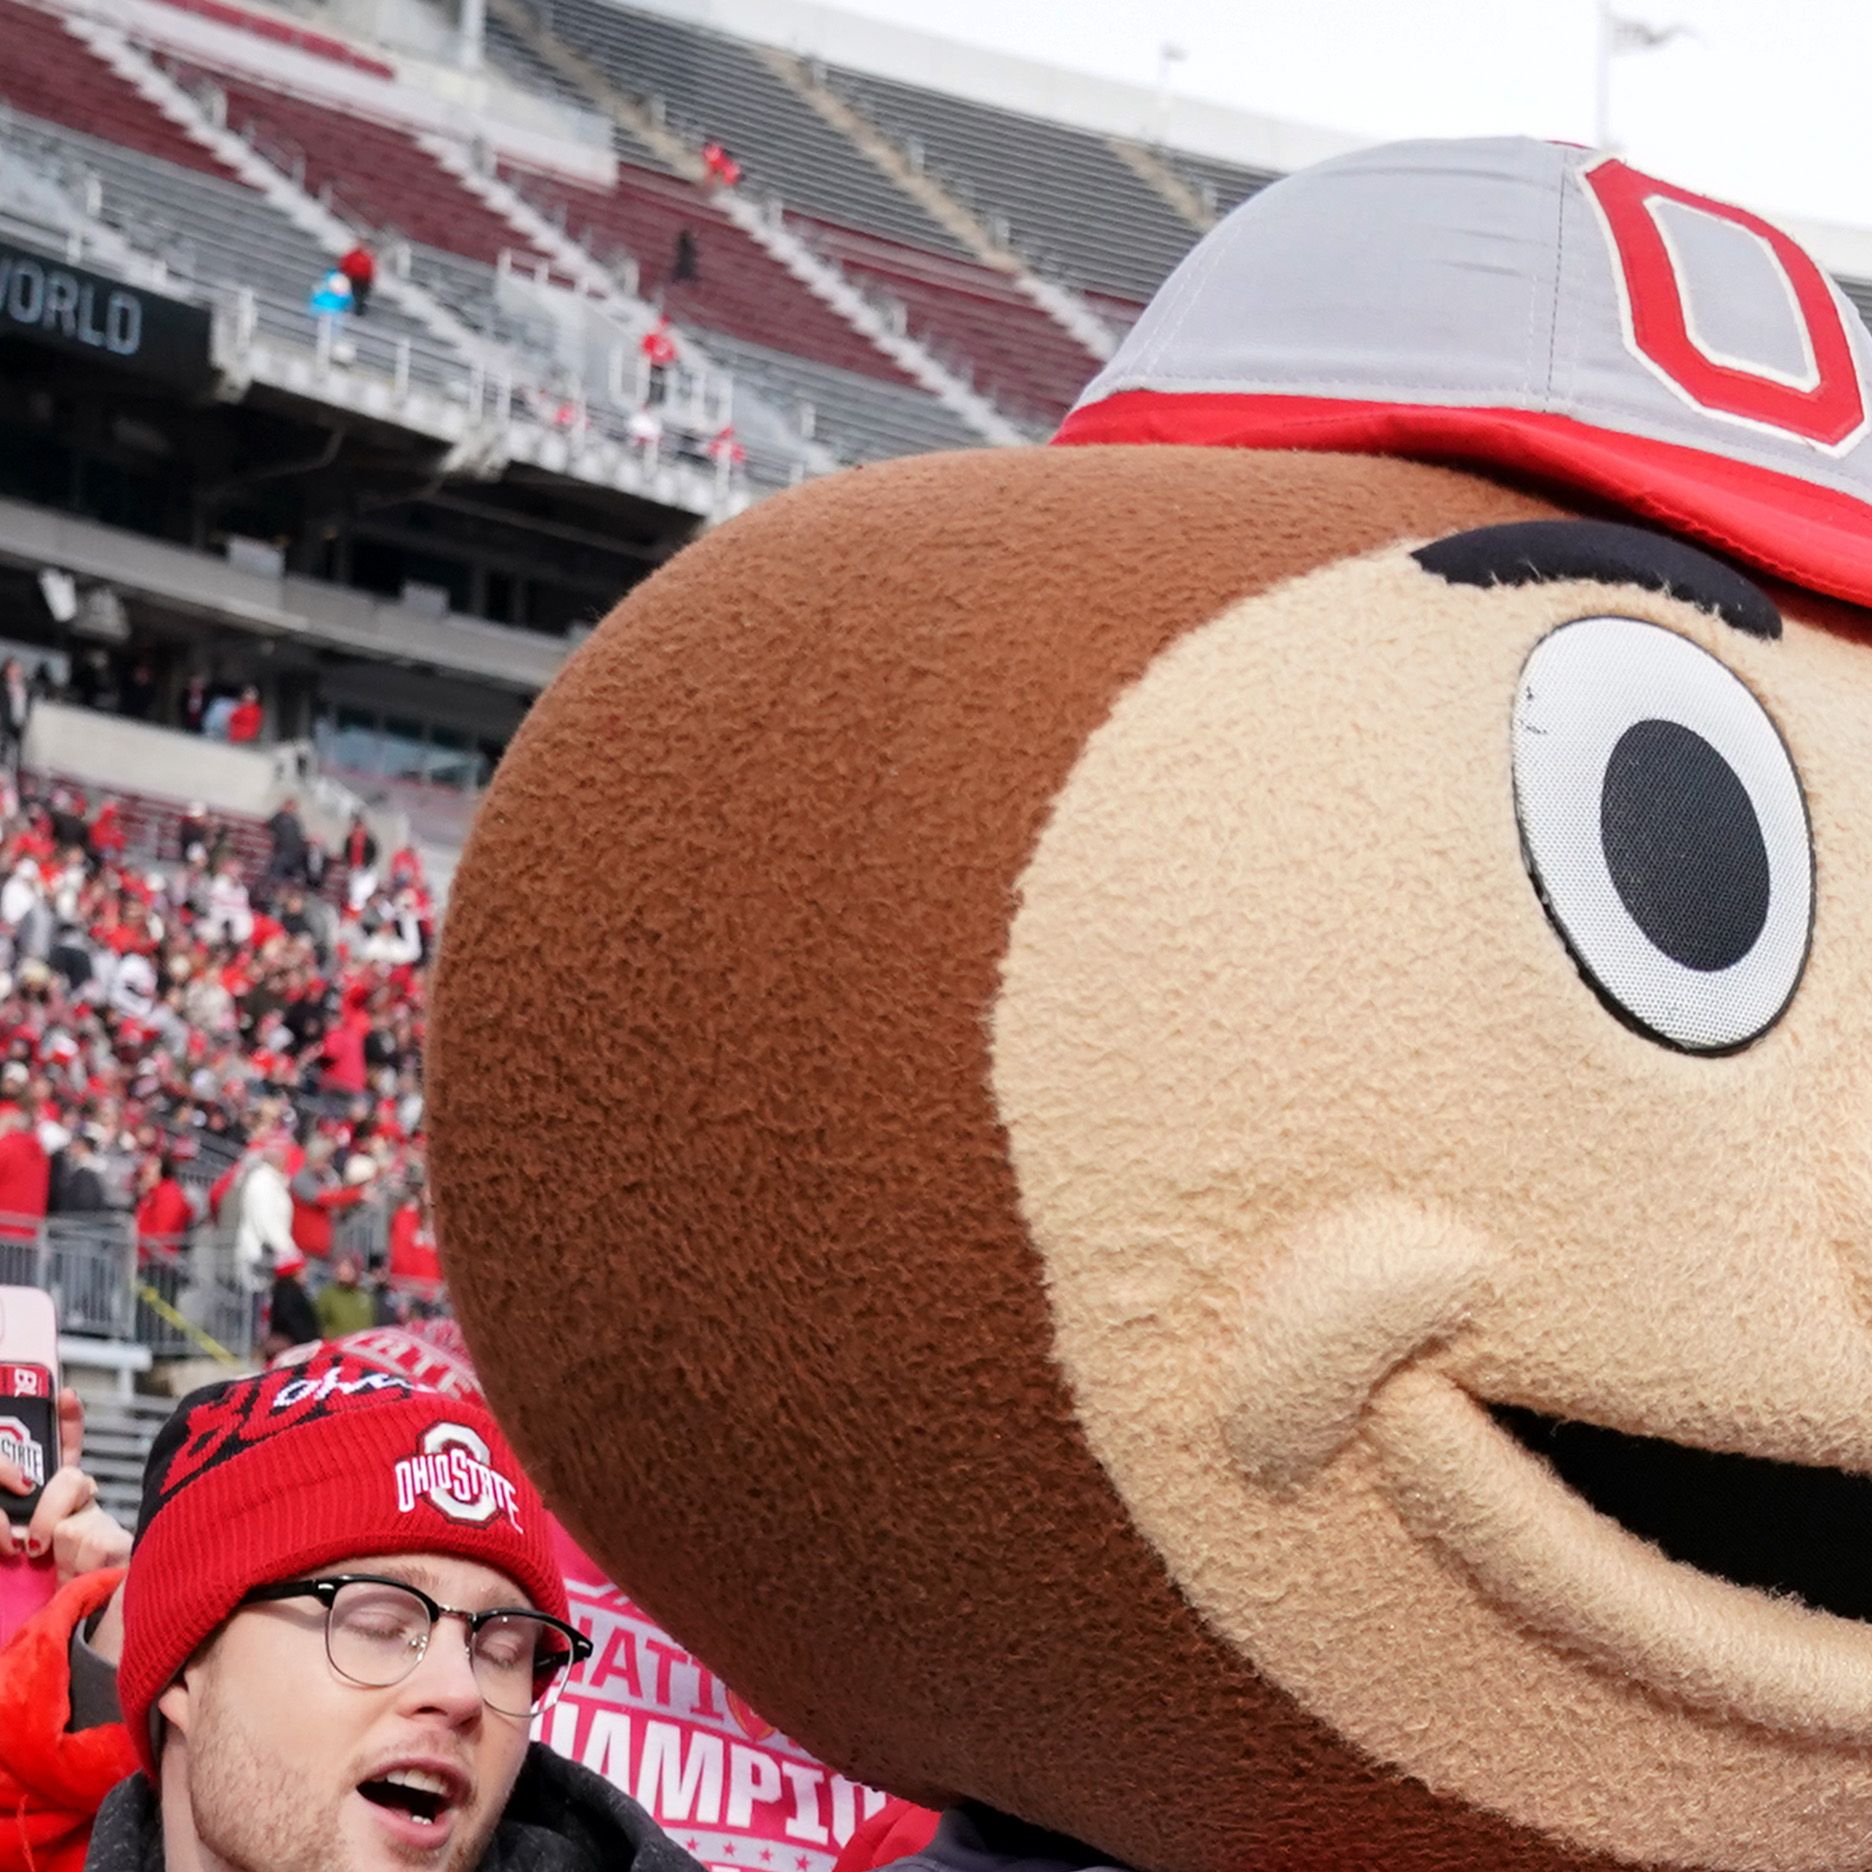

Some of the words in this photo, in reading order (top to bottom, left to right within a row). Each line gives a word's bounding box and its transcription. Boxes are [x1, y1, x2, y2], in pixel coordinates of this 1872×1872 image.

[1575, 150, 1872, 459] O
[394, 1454, 451, 1513] OHIO
[448, 1448, 524, 1534] STATE
